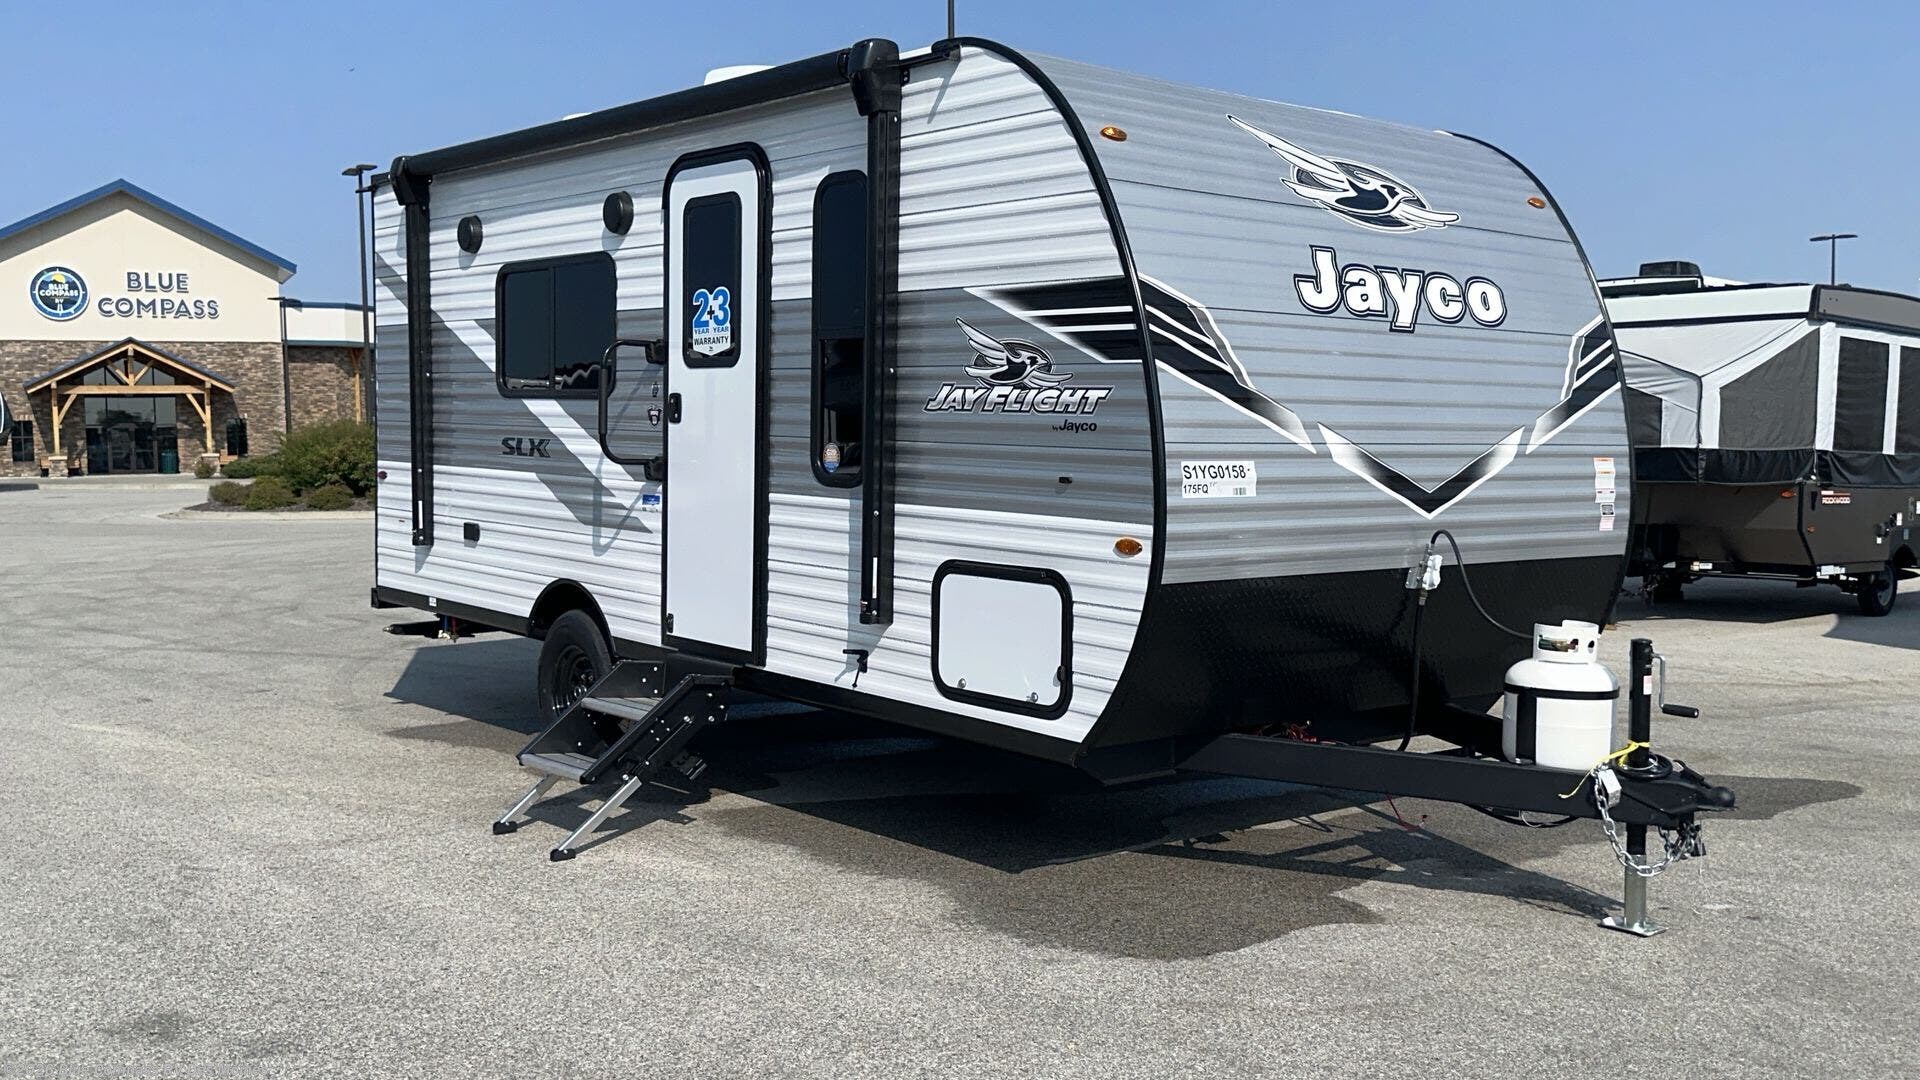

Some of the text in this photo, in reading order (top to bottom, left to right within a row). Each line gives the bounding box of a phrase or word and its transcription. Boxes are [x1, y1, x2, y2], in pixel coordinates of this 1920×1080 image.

[126, 271, 189, 293] BLUE
[1294, 244, 1508, 333] Jayco
[97, 297, 219, 320] COMPASS
[694, 336, 729, 346] WARRANTY
[924, 383, 1114, 415] JAY FLIGHT
[1059, 419, 1097, 434] Jayco
[501, 437, 551, 458] SLK
[1183, 465, 1247, 480] S1YG0158
[1183, 484, 1209, 495] 175FQ
